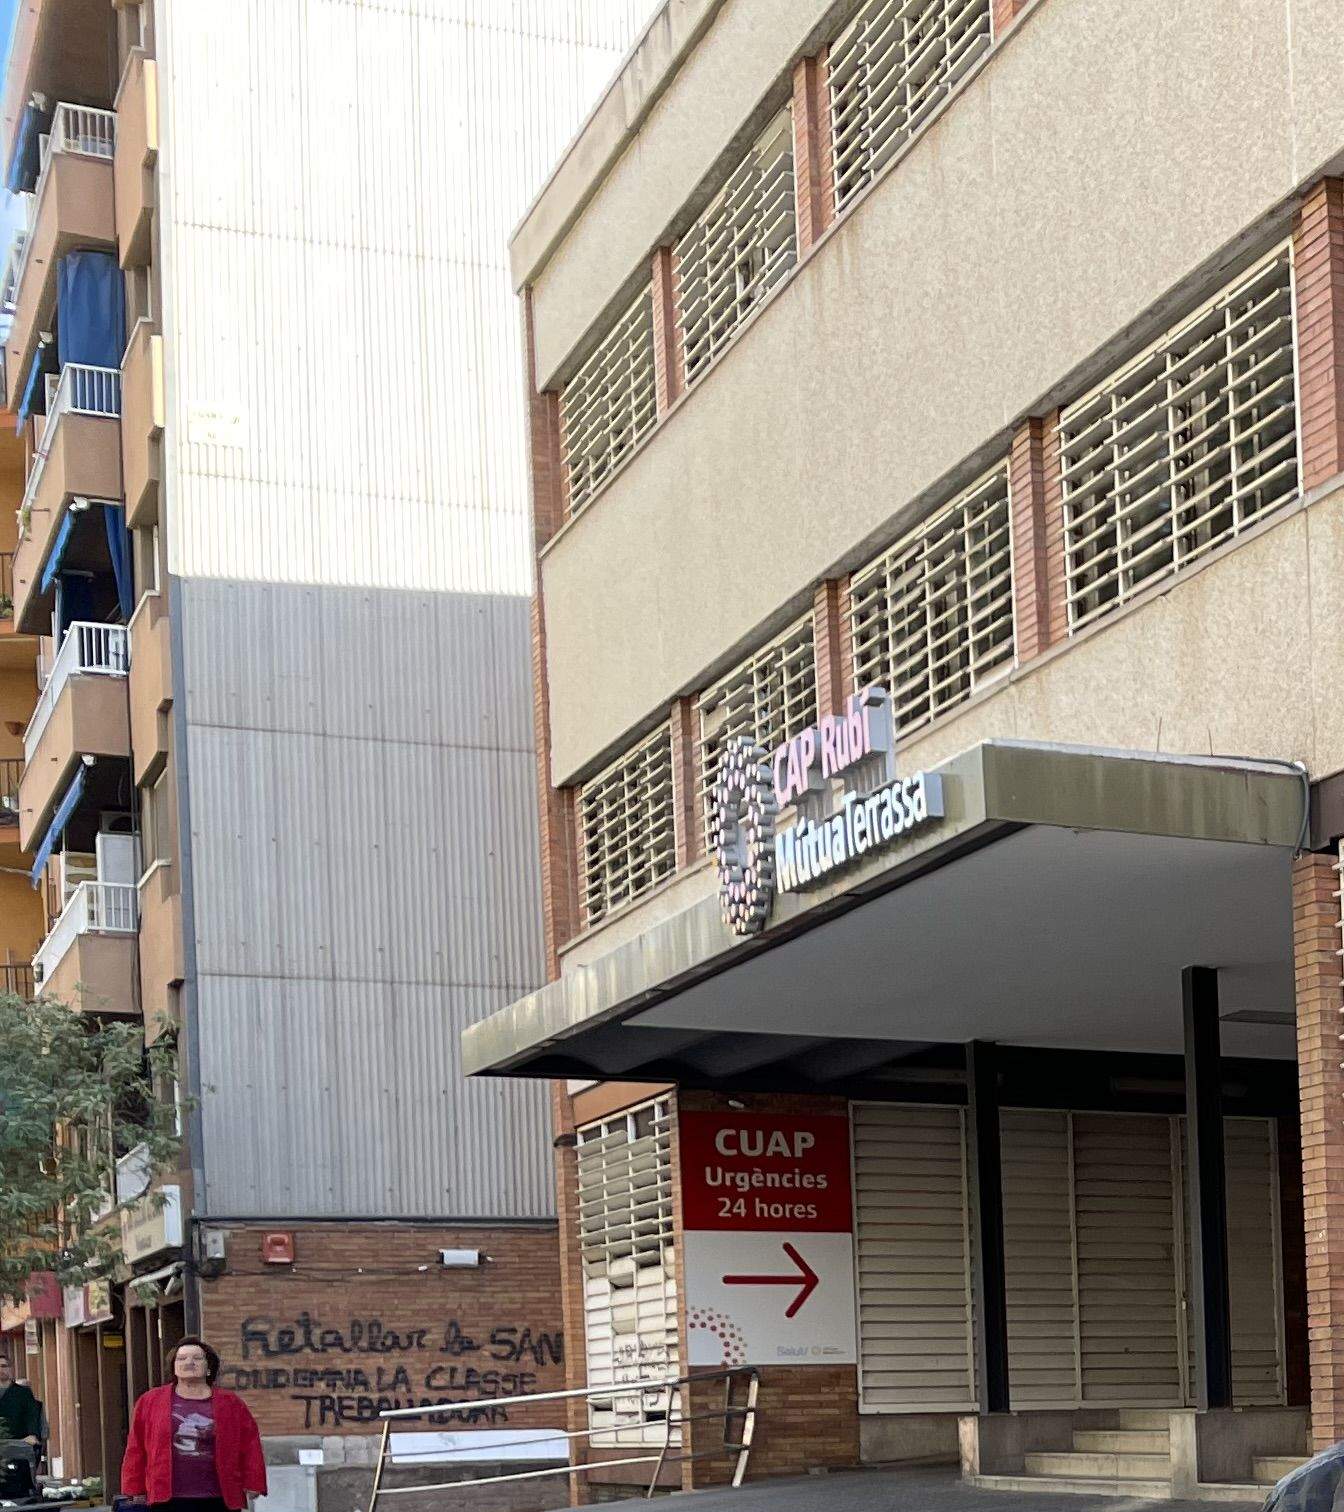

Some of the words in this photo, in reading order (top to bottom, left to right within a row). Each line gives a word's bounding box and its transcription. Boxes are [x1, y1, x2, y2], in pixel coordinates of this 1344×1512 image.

[773, 727, 816, 807] CAP
[715, 1128, 816, 1158] CUAP
[705, 1166, 828, 1192] Urgències
[718, 1197, 747, 1218] 24
[755, 1198, 818, 1219] hores
